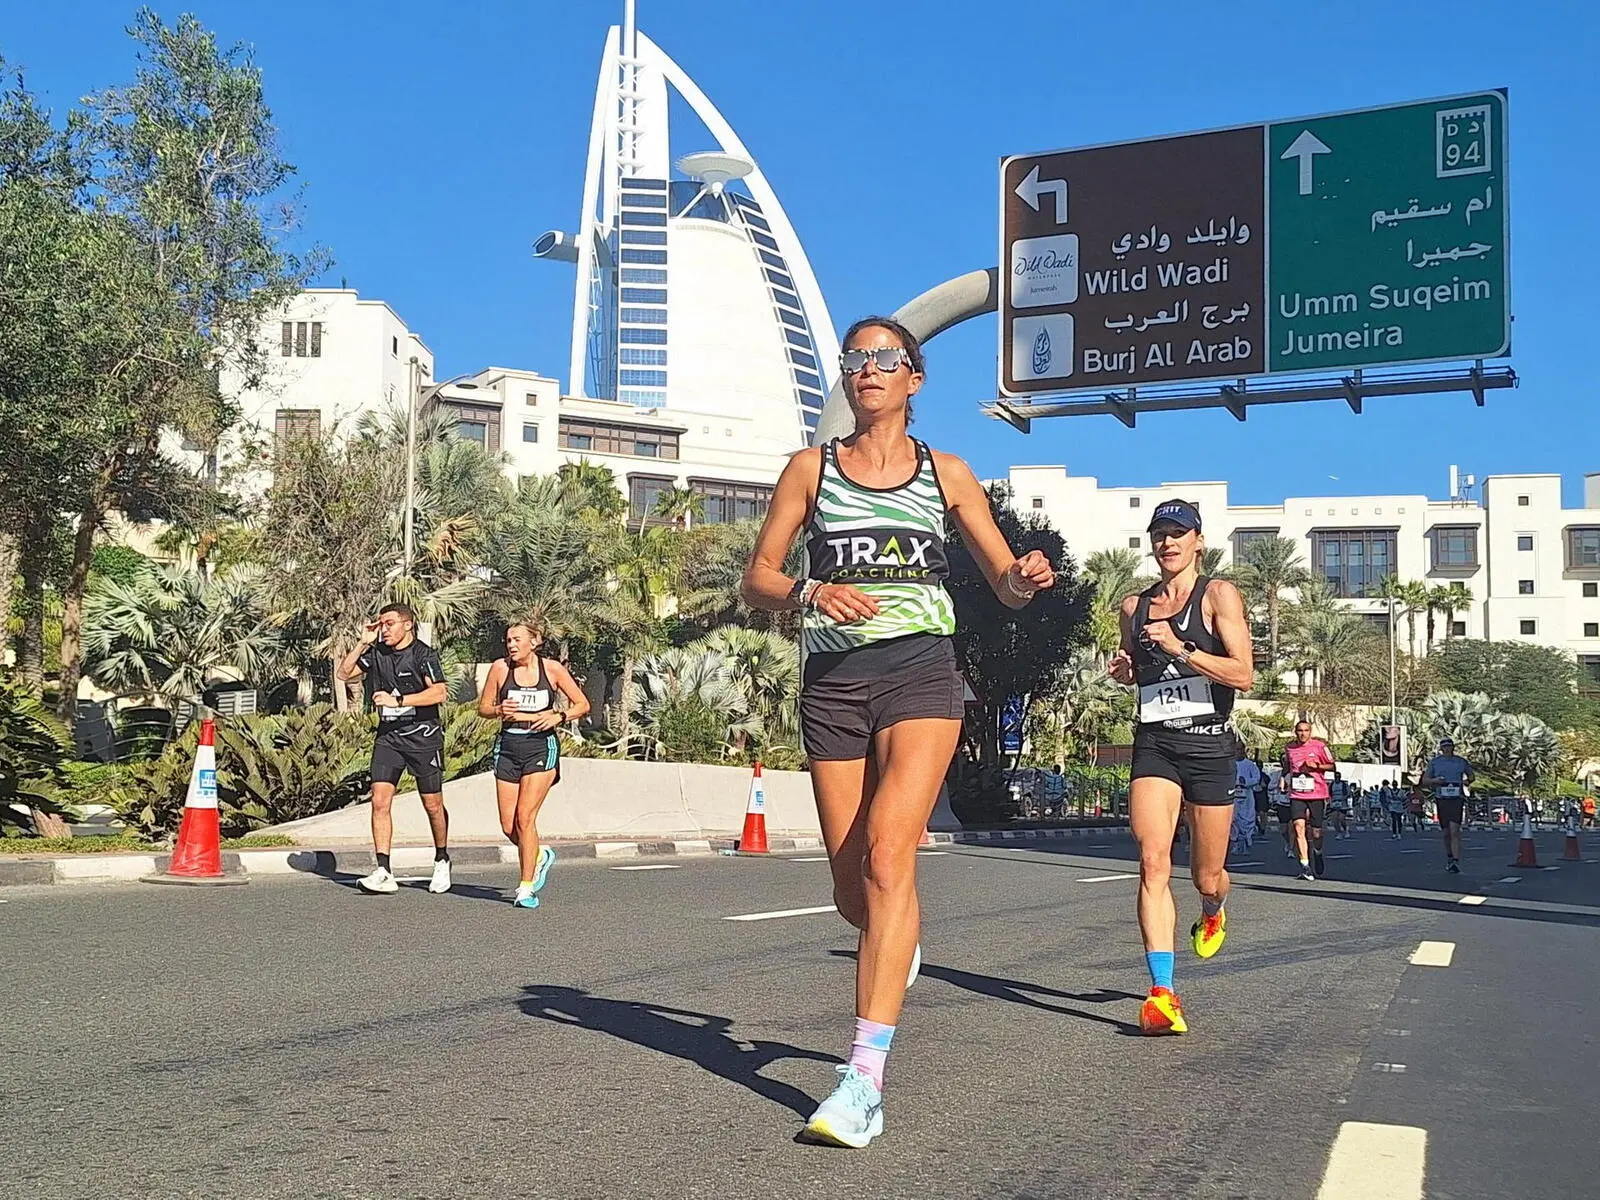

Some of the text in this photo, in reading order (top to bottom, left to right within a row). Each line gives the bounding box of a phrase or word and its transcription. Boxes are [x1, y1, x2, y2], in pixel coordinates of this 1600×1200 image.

[1446, 123, 1459, 137] D
[1445, 140, 1481, 167] 94
[1371, 198, 1452, 233] سقيم
[1111, 215, 1251, 260] وايلد وادي
[1407, 239, 1492, 268] جميرا
[1084, 257, 1229, 296] Wild Wadi
[1280, 276, 1491, 318] Umm Suqeim
[1104, 299, 1251, 334] برج العرب
[1083, 345, 1136, 374] Burj
[1144, 342, 1175, 368] Al
[1186, 336, 1252, 364] Arab
[1280, 322, 1404, 356] Jumeira
[826, 535, 932, 568] TRAX
[520, 694, 536, 704] 771
[1157, 684, 1190, 706] 1211
